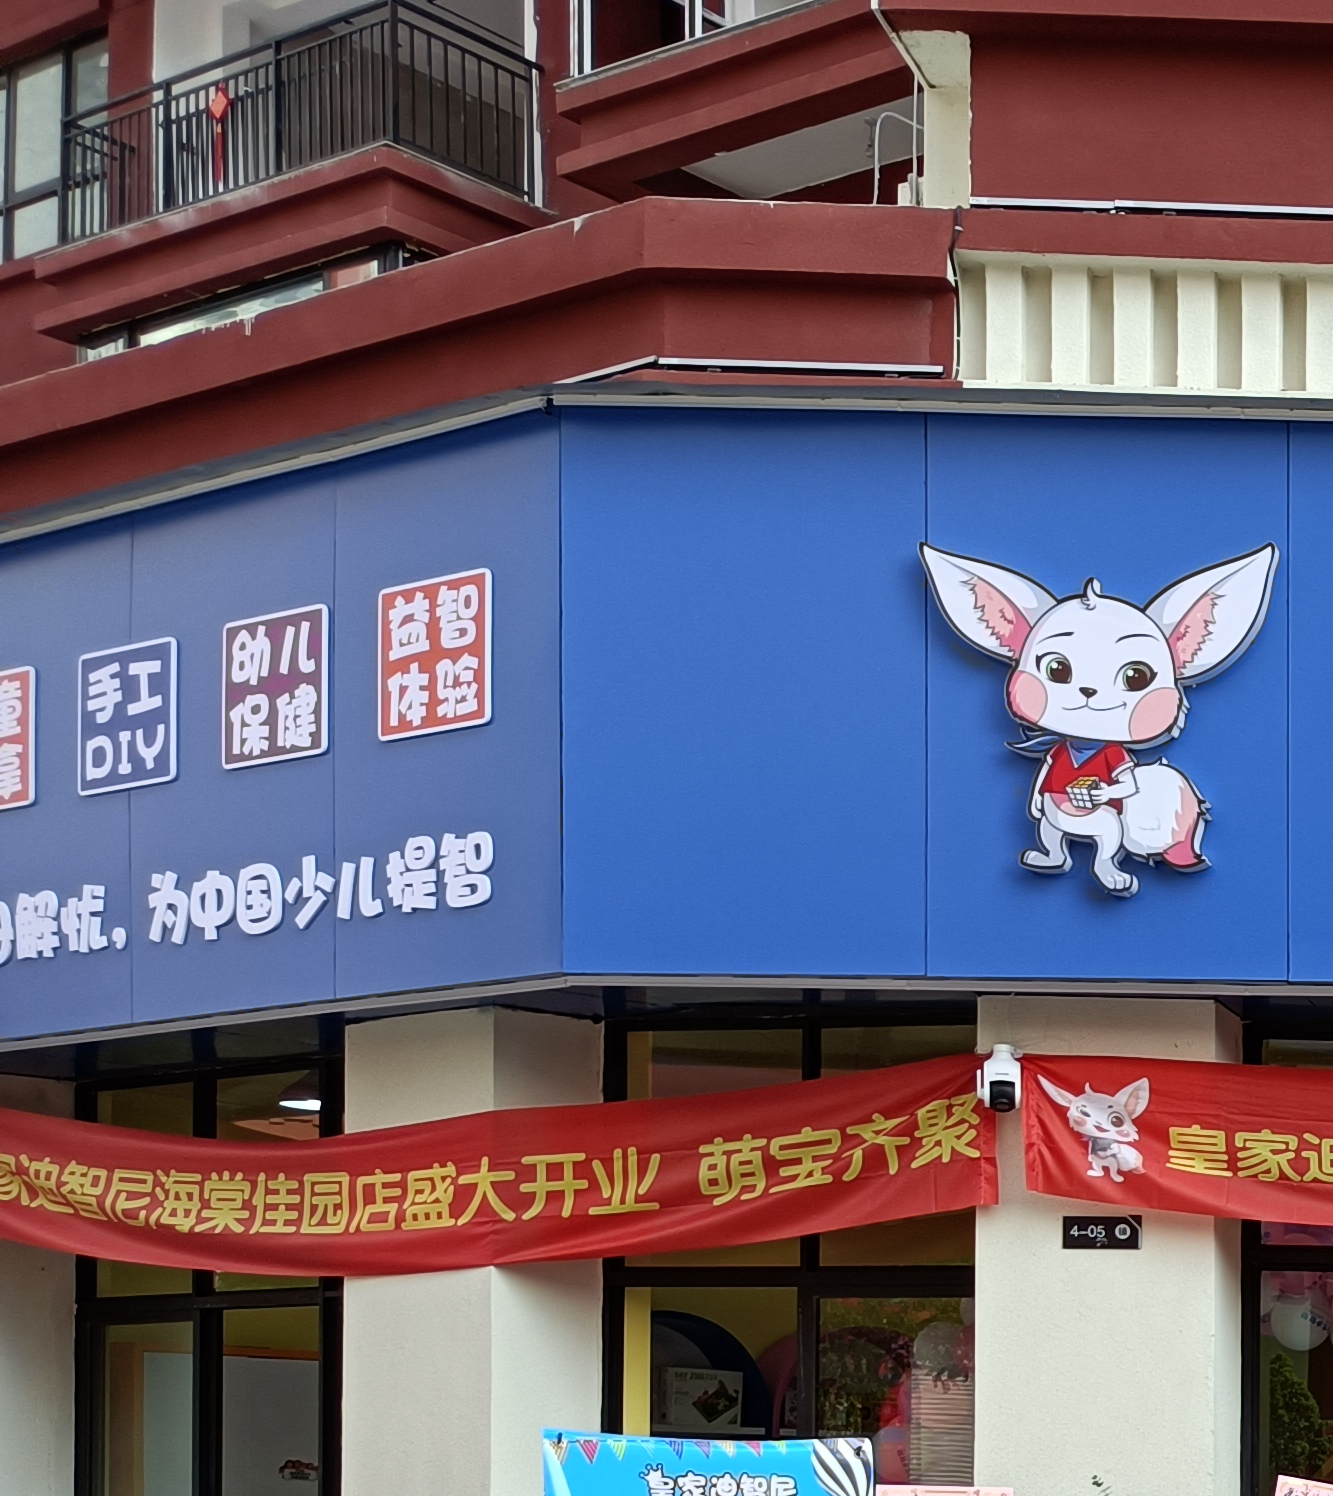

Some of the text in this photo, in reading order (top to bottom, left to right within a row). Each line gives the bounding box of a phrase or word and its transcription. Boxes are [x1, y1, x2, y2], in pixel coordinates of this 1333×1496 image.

[231, 620, 316, 686] 幼儿
[388, 585, 479, 661] 益智
[87, 660, 163, 724] 手工
[229, 682, 318, 757] 保健
[387, 653, 480, 727] 体验
[86, 723, 165, 781] DIY
[699, 1091, 982, 1206] 萌宝齐聚
